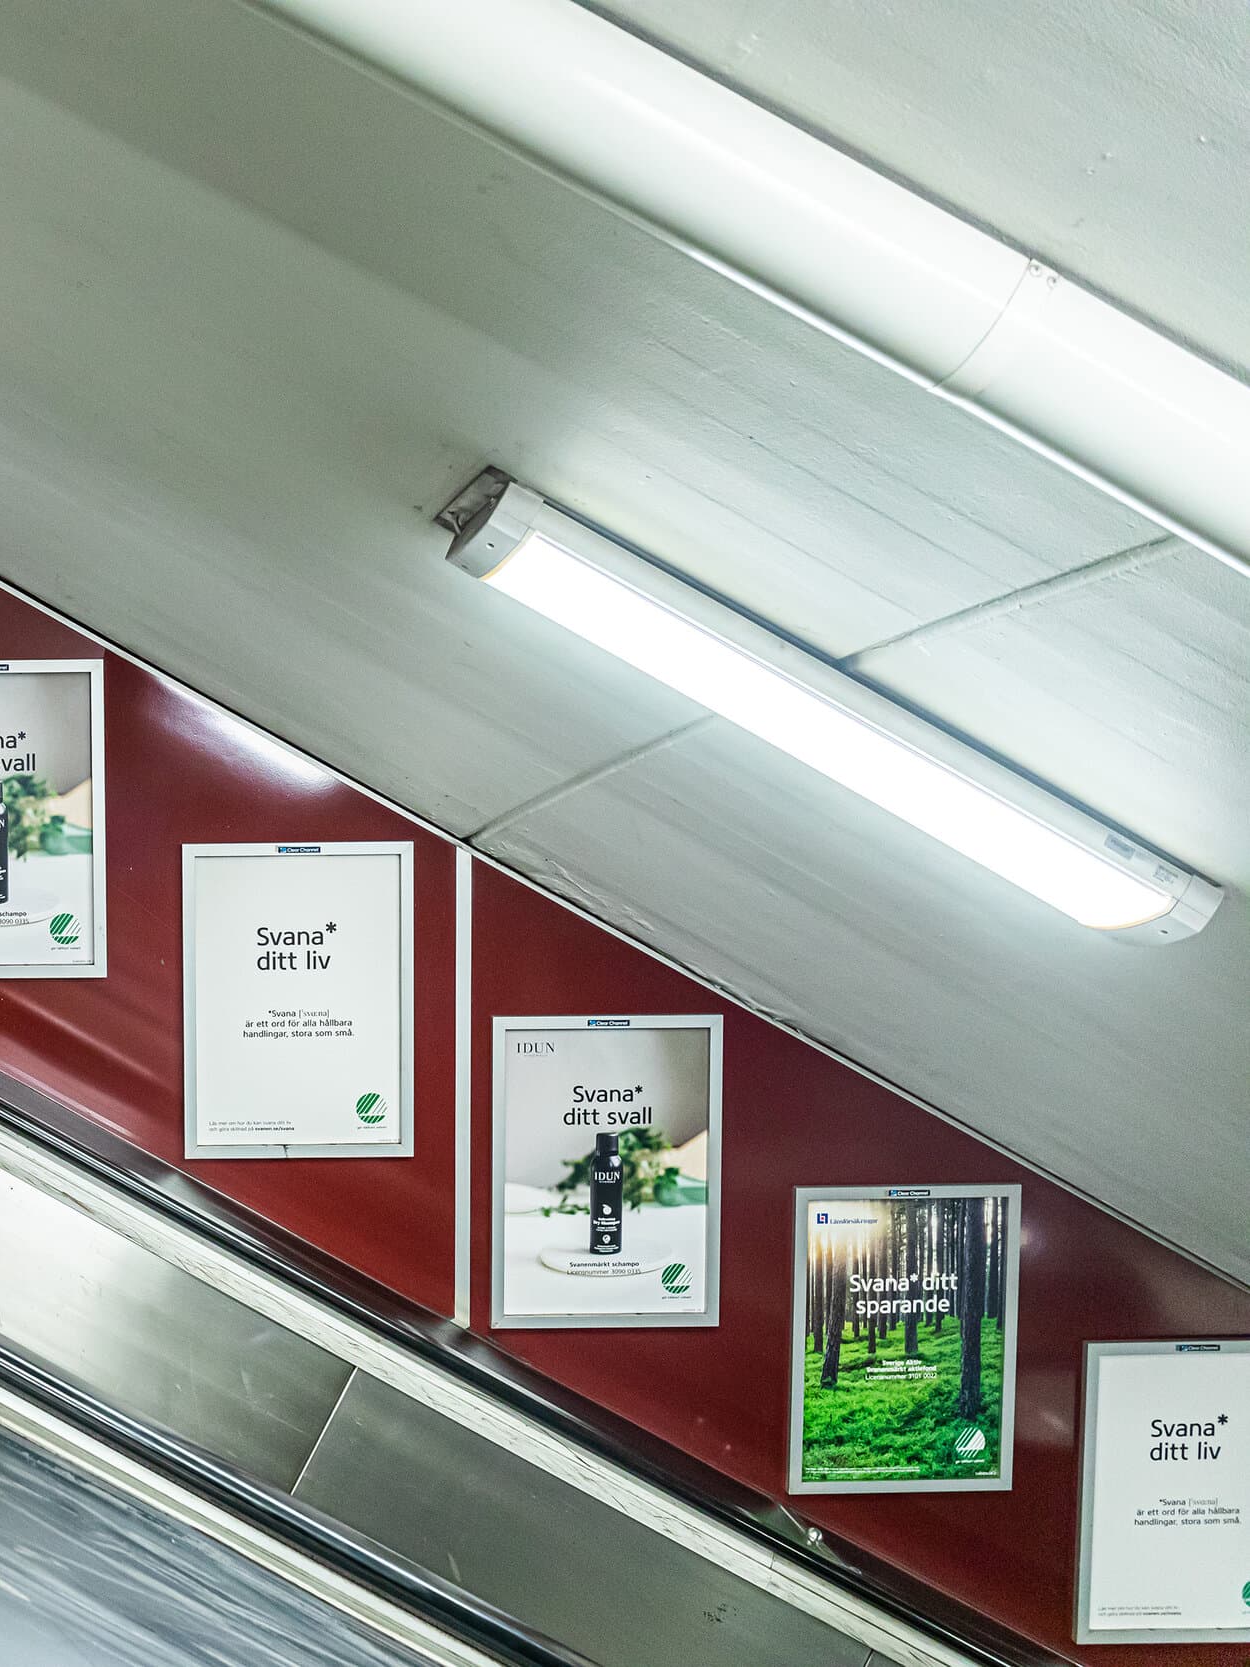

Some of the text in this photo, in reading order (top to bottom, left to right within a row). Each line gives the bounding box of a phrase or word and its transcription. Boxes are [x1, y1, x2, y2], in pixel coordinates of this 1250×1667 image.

[257, 950, 331, 970] ditt liv
[245, 1020, 254, 1028] är
[271, 1019, 285, 1027] ord
[288, 1019, 299, 1027] för
[243, 1030, 288, 1039] handlingar,
[291, 1030, 312, 1038] stora
[335, 1028, 355, 1036] små.
[517, 1042, 555, 1053] IDUN
[563, 1107, 652, 1125] ditt svall
[594, 1172, 620, 1180] IDUN
[923, 1273, 958, 1291] ditt
[856, 1295, 950, 1318] sparande
[1150, 1442, 1221, 1461] ditt liv
[1223, 1516, 1241, 1524] små.
